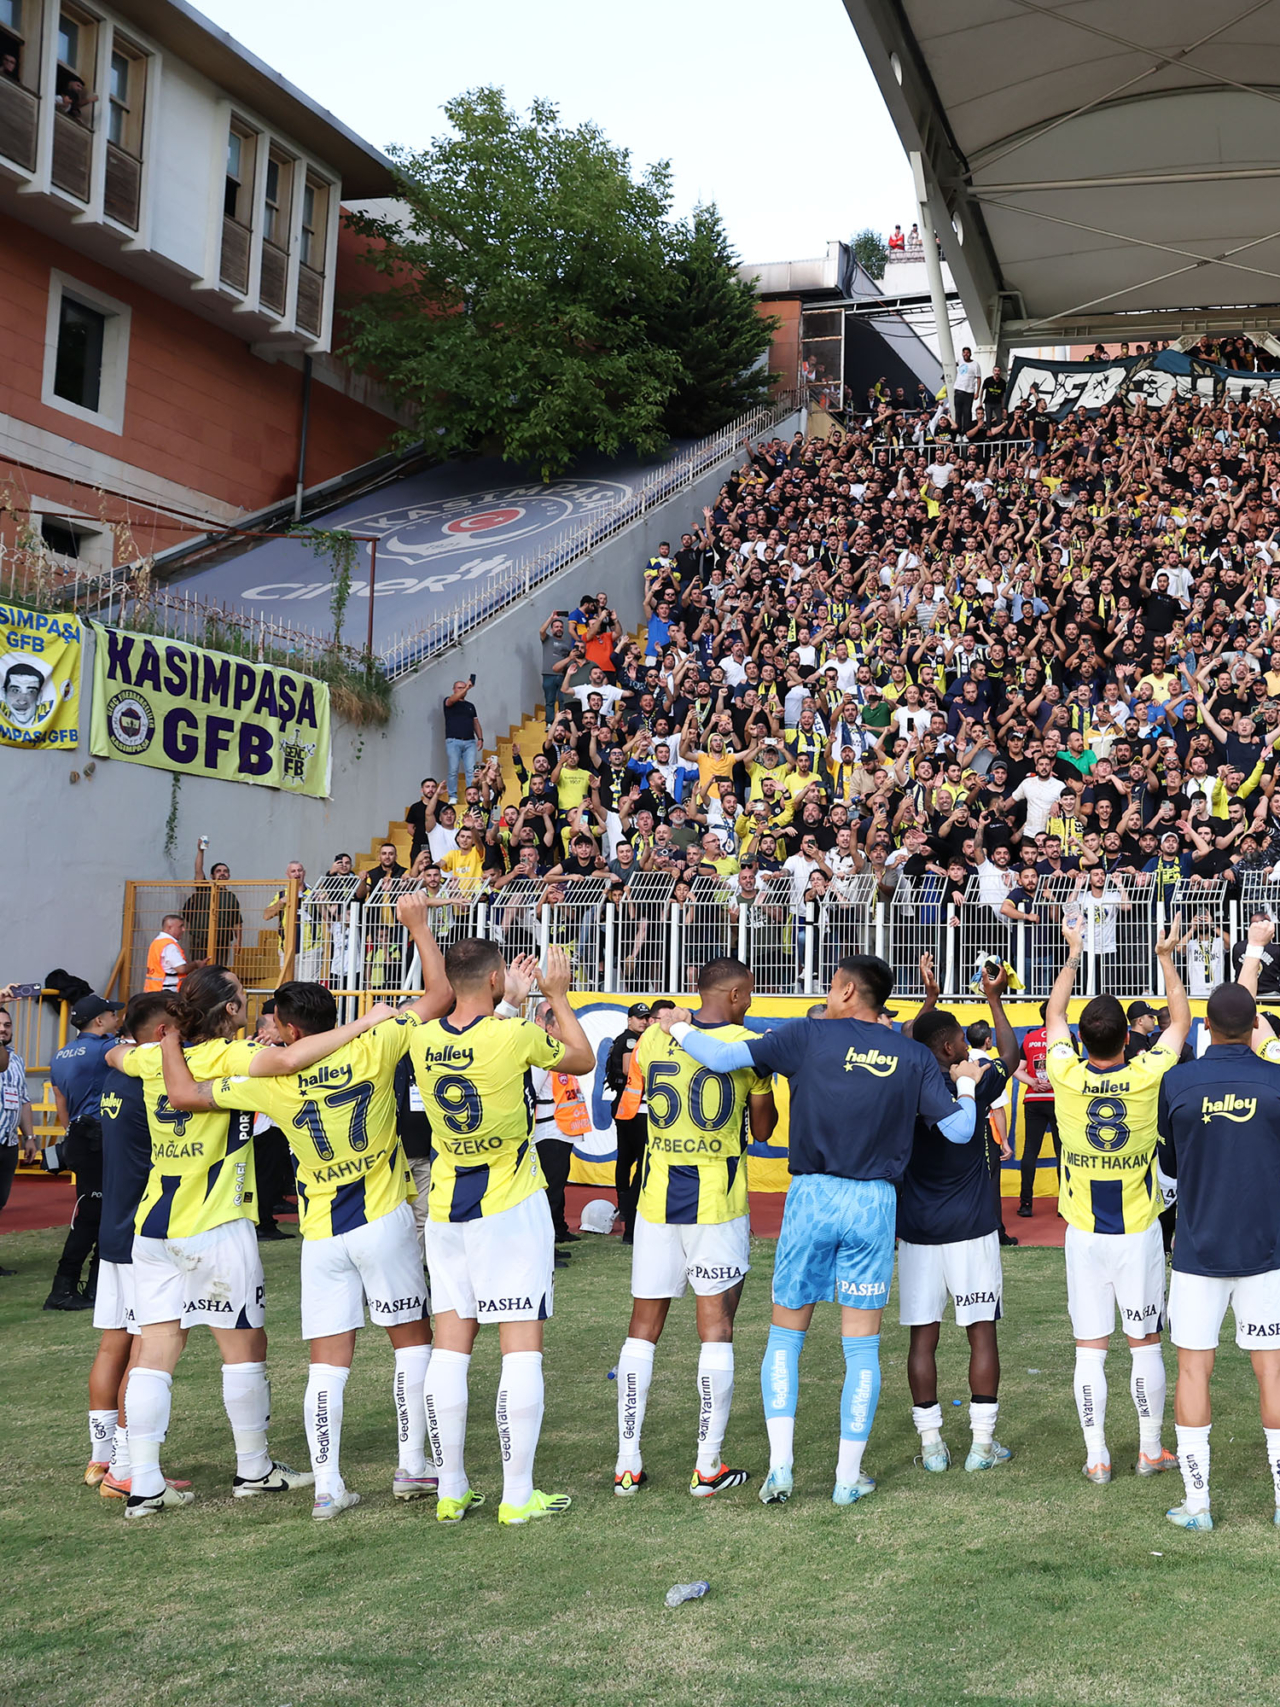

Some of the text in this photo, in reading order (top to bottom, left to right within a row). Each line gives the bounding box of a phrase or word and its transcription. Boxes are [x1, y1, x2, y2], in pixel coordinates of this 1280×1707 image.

[6, 631, 45, 653] GFB
[105, 629, 318, 733] KASIMPAŞA
[48, 728, 78, 744] GFB
[163, 707, 274, 776] GFB
[284, 758, 304, 776] FB
[425, 1045, 473, 1071] halley
[845, 1047, 898, 1077] halley
[298, 1063, 353, 1090] halley
[434, 1075, 483, 1134] 9
[647, 1061, 735, 1132] 50
[1202, 1094, 1256, 1122] halley
[154, 1094, 193, 1137] 4
[239, 1110, 251, 1141] POR
[293, 1081, 374, 1161] 17
[1086, 1097, 1130, 1153] 8
[651, 1136, 722, 1154] R.BECÃO
[1066, 1151, 1149, 1170] MERT HAKAN
[695, 1266, 742, 1280] PASHA
[841, 1281, 886, 1296] PASHA
[956, 1291, 996, 1307] PASHA
[375, 1296, 422, 1314] PASHA
[477, 1297, 533, 1313] PASHA
